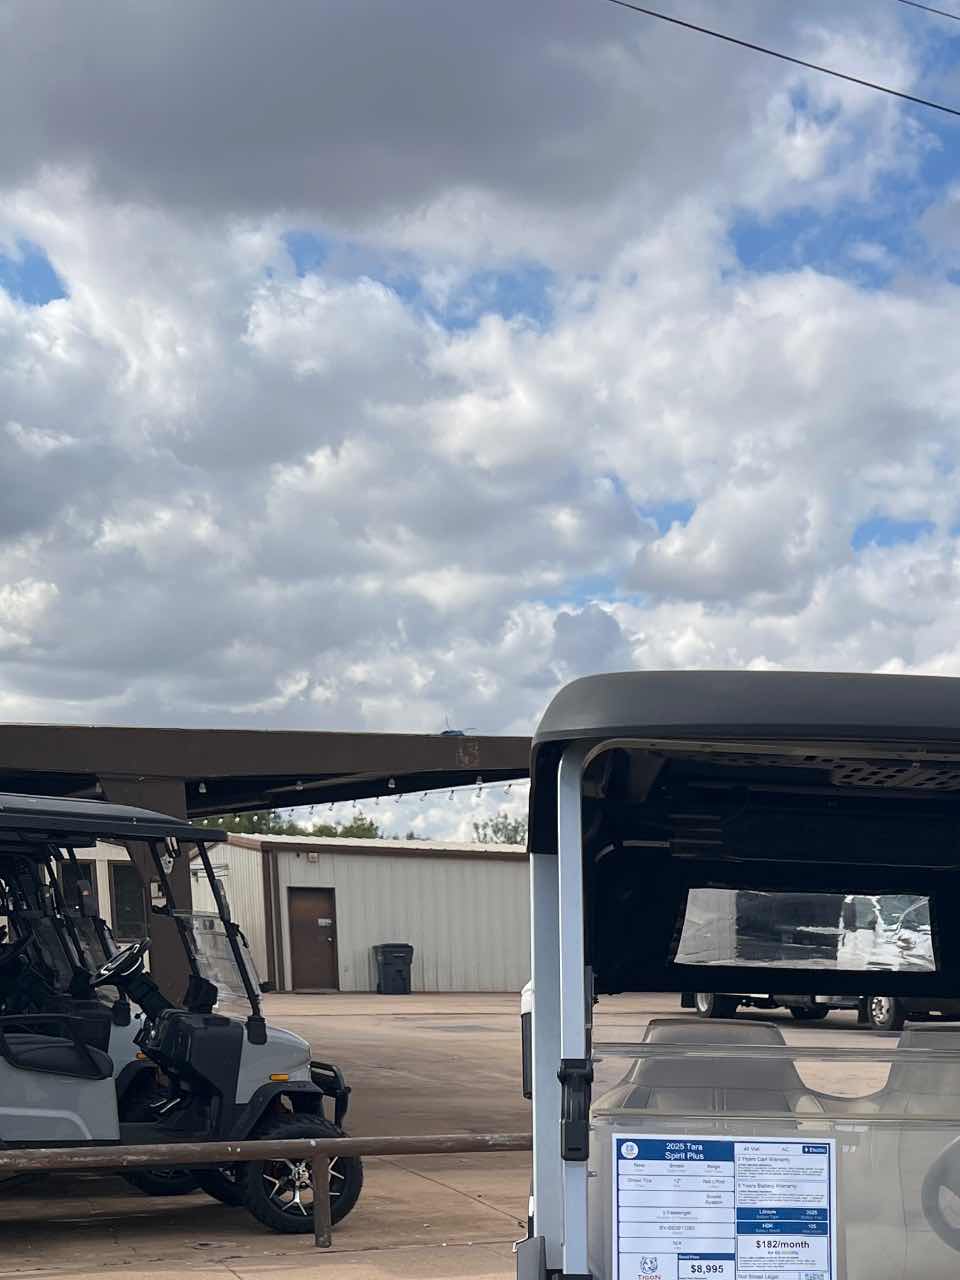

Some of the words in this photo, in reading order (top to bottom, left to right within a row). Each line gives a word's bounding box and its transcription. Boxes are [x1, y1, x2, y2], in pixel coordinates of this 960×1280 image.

[666, 1142, 685, 1150] 2025
[686, 1143, 703, 1151] Tara
[665, 1152, 686, 1161] Spirit
[687, 1152, 705, 1160] Plus
[755, 1240, 810, 1249] $182/month
[690, 1264, 724, 1275] $8,995
